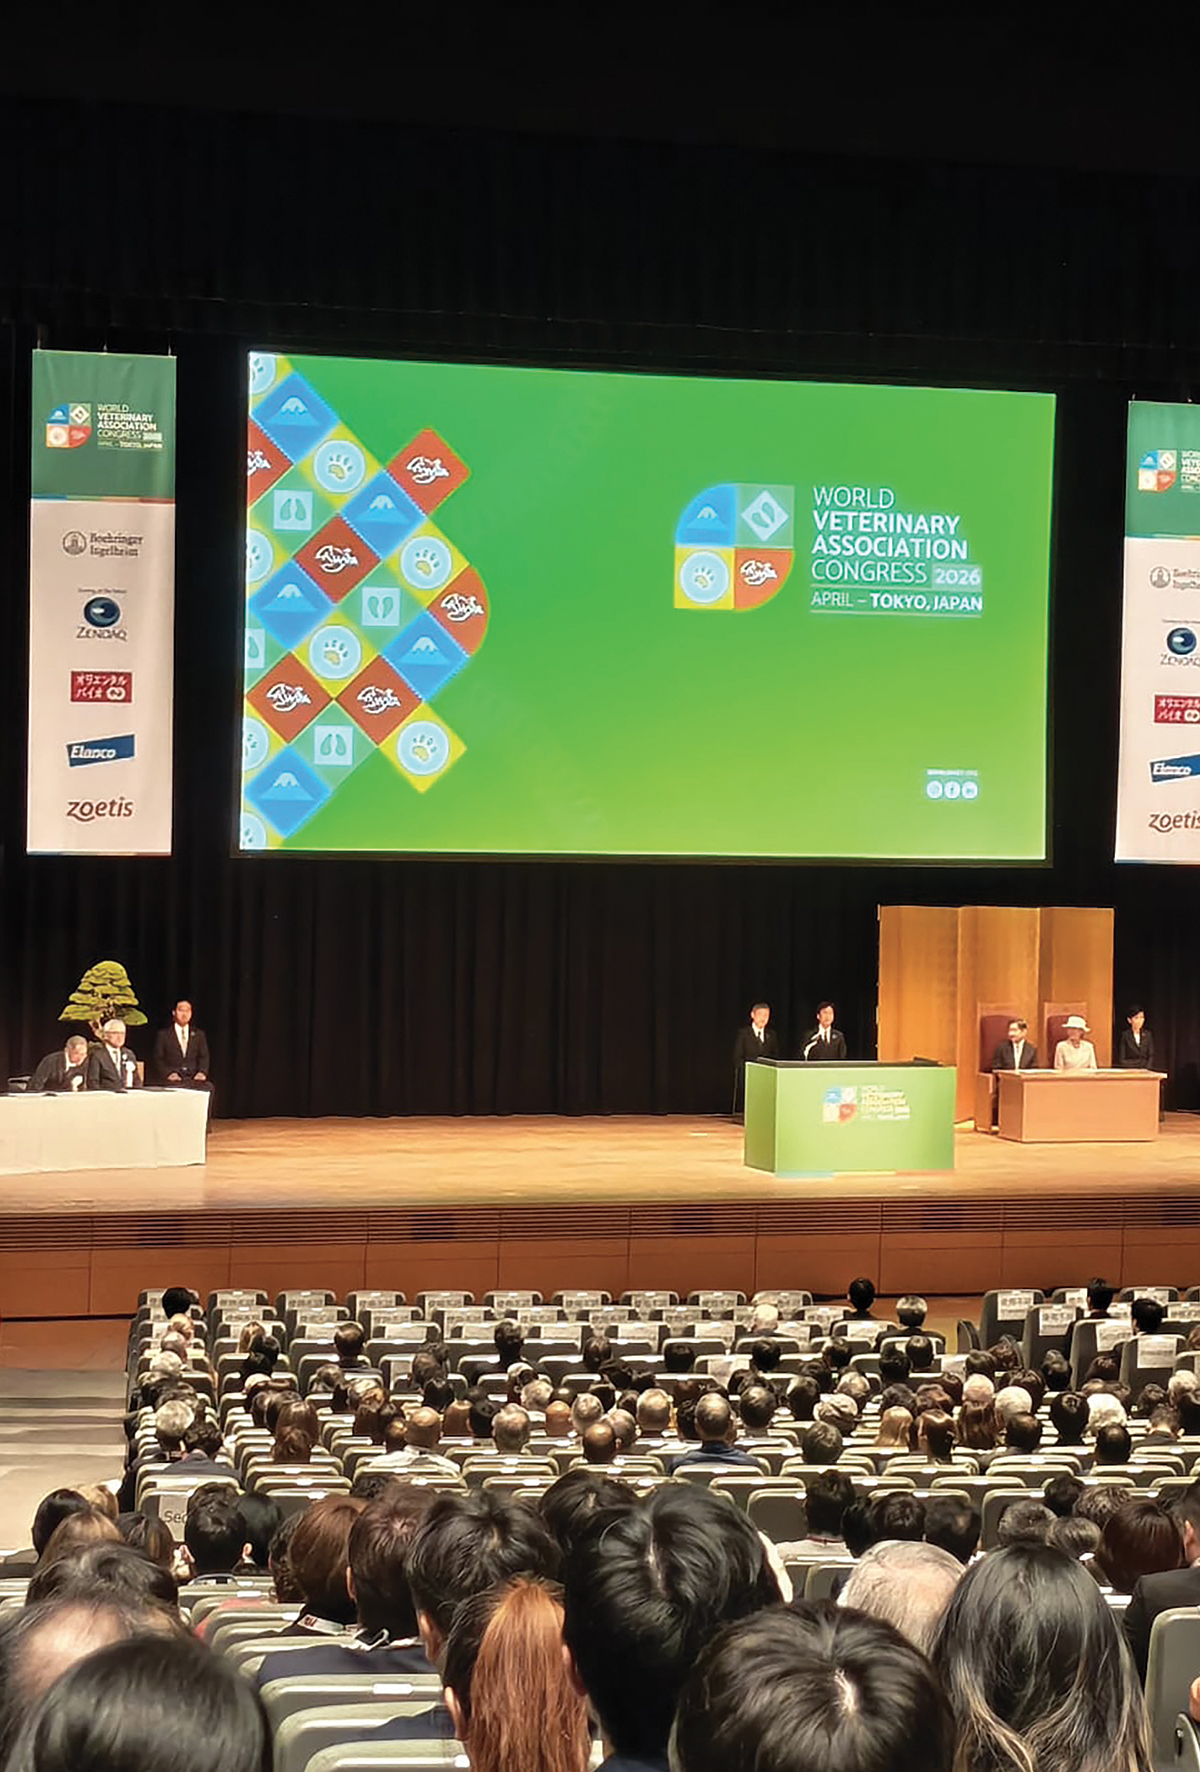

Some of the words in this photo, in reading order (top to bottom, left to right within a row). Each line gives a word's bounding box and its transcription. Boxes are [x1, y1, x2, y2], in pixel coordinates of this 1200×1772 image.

[97, 412, 153, 422] VETERINARY
[97, 421, 157, 431] ASSOCIATION
[813, 486, 894, 509] WORLD
[812, 510, 960, 535] VETERINARY
[812, 534, 968, 560] ASSOCIATION
[812, 559, 927, 583] CONGRESS
[934, 567, 981, 586] 2026
[811, 591, 854, 608] APRIL
[870, 593, 931, 611] TOKYO,
[932, 596, 983, 611] JAPAN
[66, 797, 134, 822] zoetis
